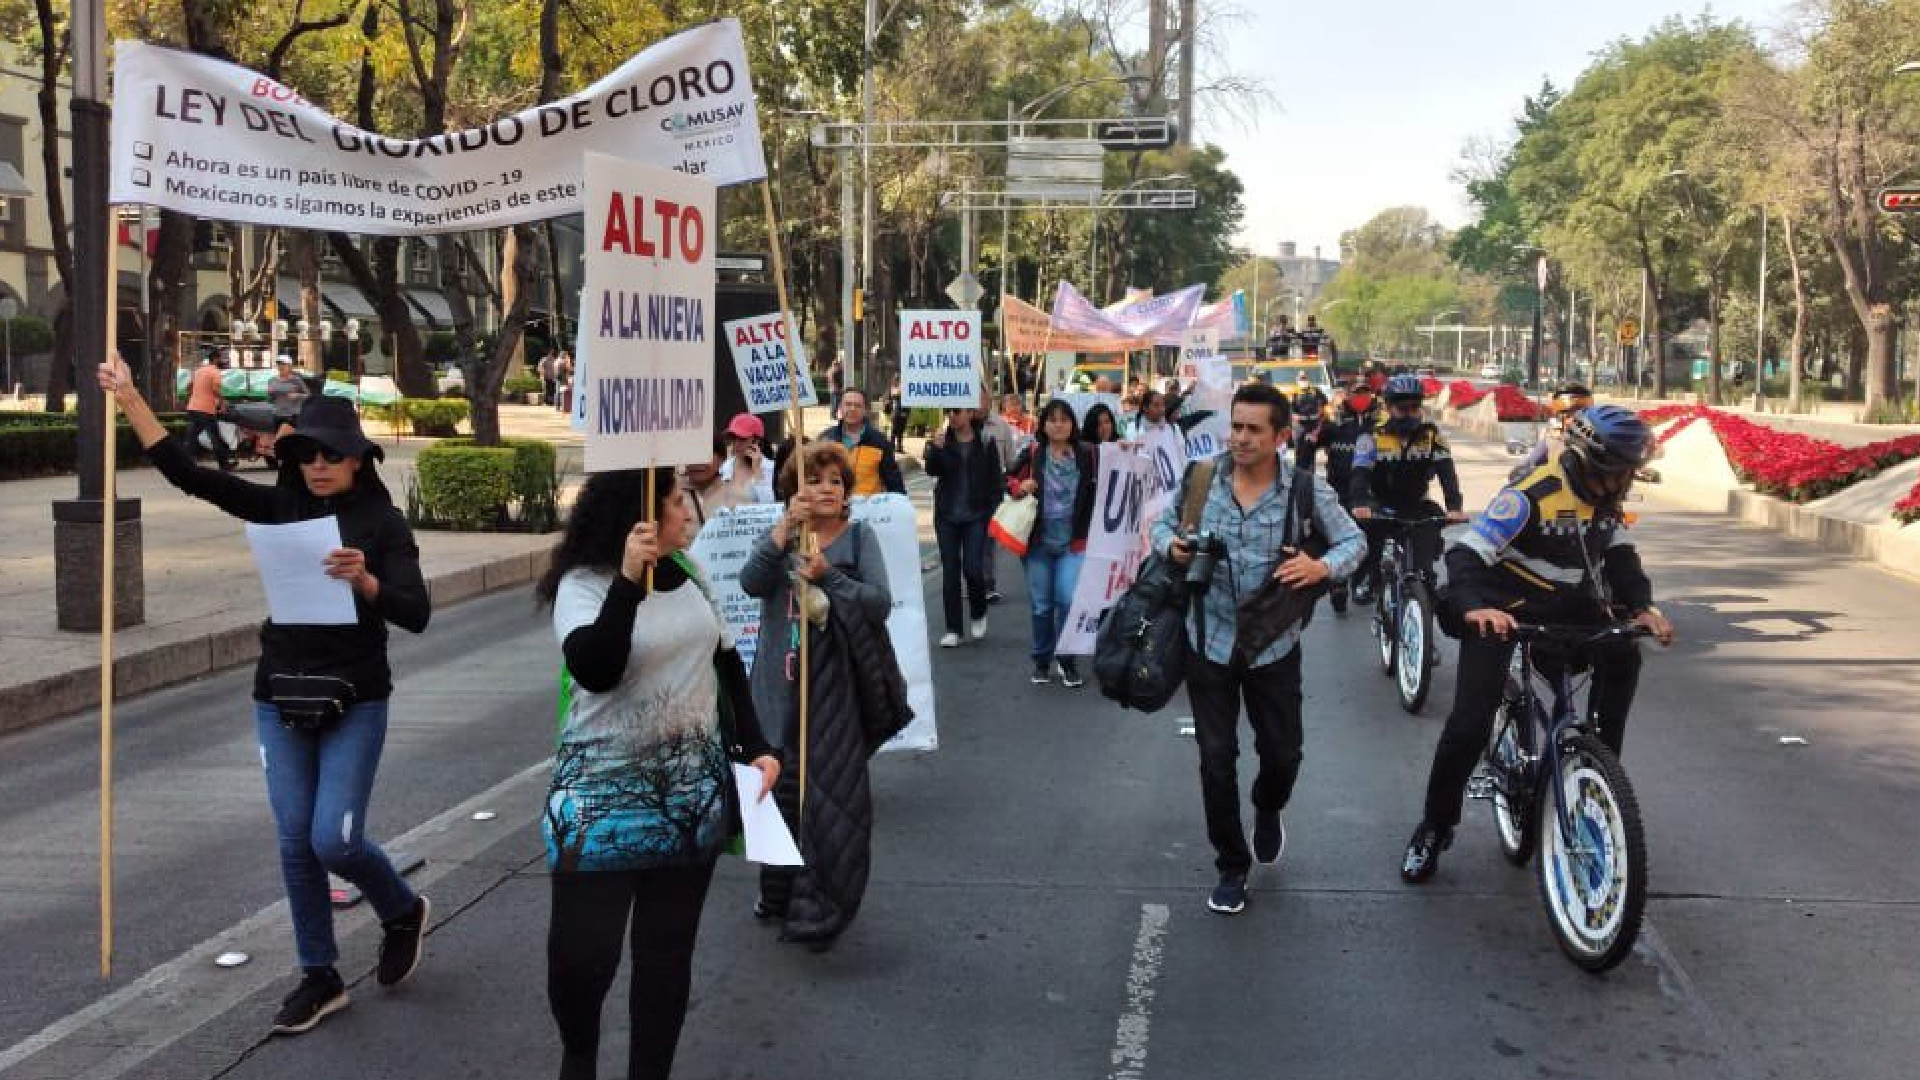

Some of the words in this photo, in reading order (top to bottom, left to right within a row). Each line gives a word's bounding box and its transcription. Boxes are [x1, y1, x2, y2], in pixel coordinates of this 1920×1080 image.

[156, 84, 226, 126] LEY
[239, 102, 316, 144] DEL
[539, 100, 593, 138] DE
[605, 59, 735, 118] CLORO
[166, 150, 230, 175] Ahora
[236, 166, 259, 179] es
[265, 167, 291, 181] un
[387, 179, 411, 198] de
[415, 178, 478, 201] COVID
[500, 168, 523, 187] 19
[166, 177, 277, 209] Mexicanos
[284, 193, 365, 217] sigamos
[369, 201, 386, 219] la
[391, 197, 501, 227] experiencia
[506, 191, 531, 209] de
[535, 183, 577, 204] este
[602, 190, 704, 264] ALTO
[599, 289, 613, 338] A
[618, 290, 642, 340] LA
[648, 293, 706, 343] NUEVA
[909, 320, 971, 340] ALTO
[751, 348, 762, 364] A
[764, 344, 785, 360] LA
[908, 353, 916, 369] A
[918, 353, 934, 370] LA
[936, 353, 972, 371] FALSA
[597, 377, 704, 435] NORMALIDAD
[908, 382, 972, 397] PANDEMIA
